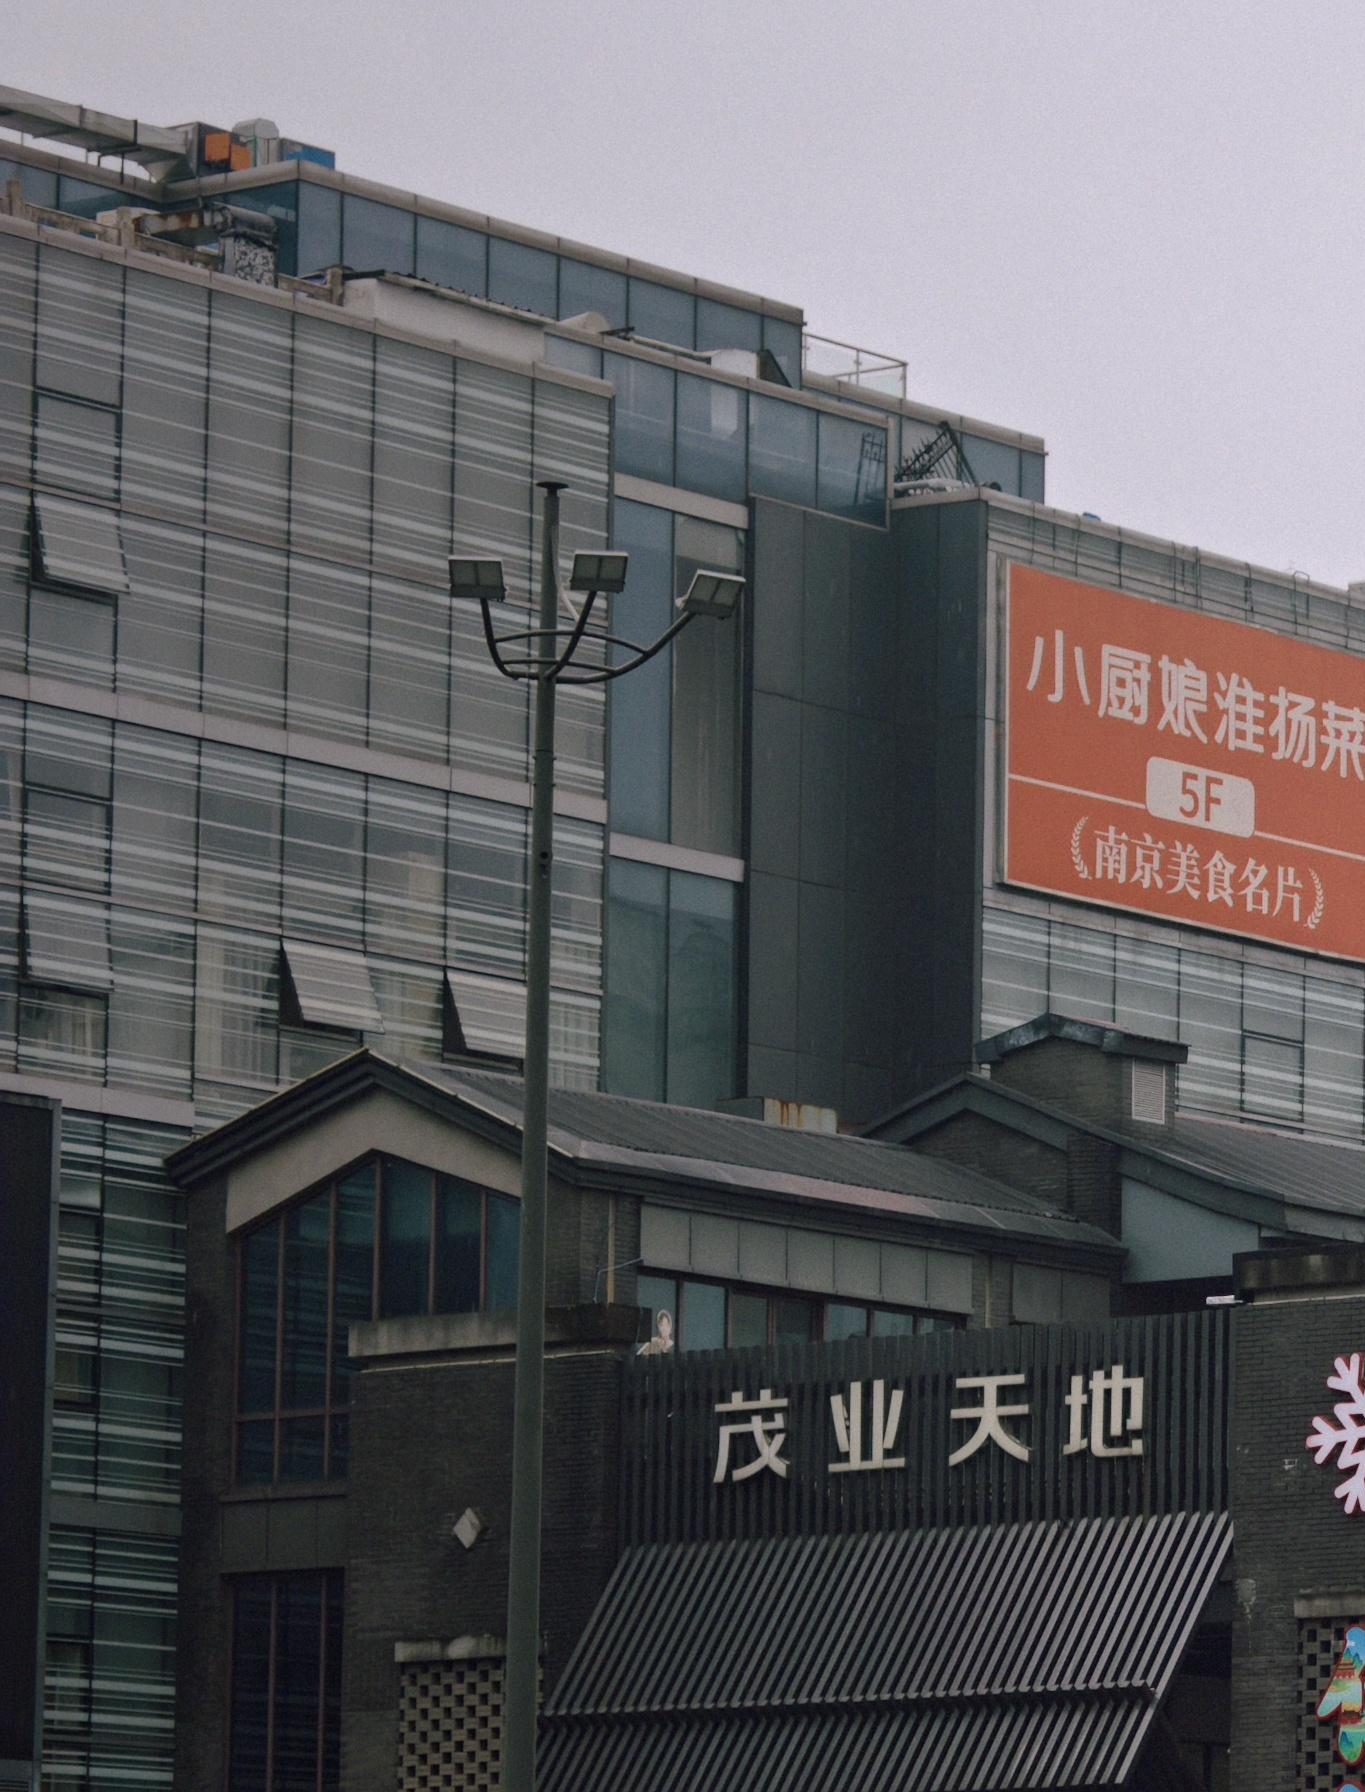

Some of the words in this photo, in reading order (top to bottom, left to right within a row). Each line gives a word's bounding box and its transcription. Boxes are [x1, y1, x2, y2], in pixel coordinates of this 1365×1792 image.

[1026, 629, 1365, 780] 小厨娘淮扬菜
[1179, 772, 1223, 825] 5F
[1094, 825, 1303, 924] 南京美食名片
[712, 1364, 1145, 1484] 茂业天地
